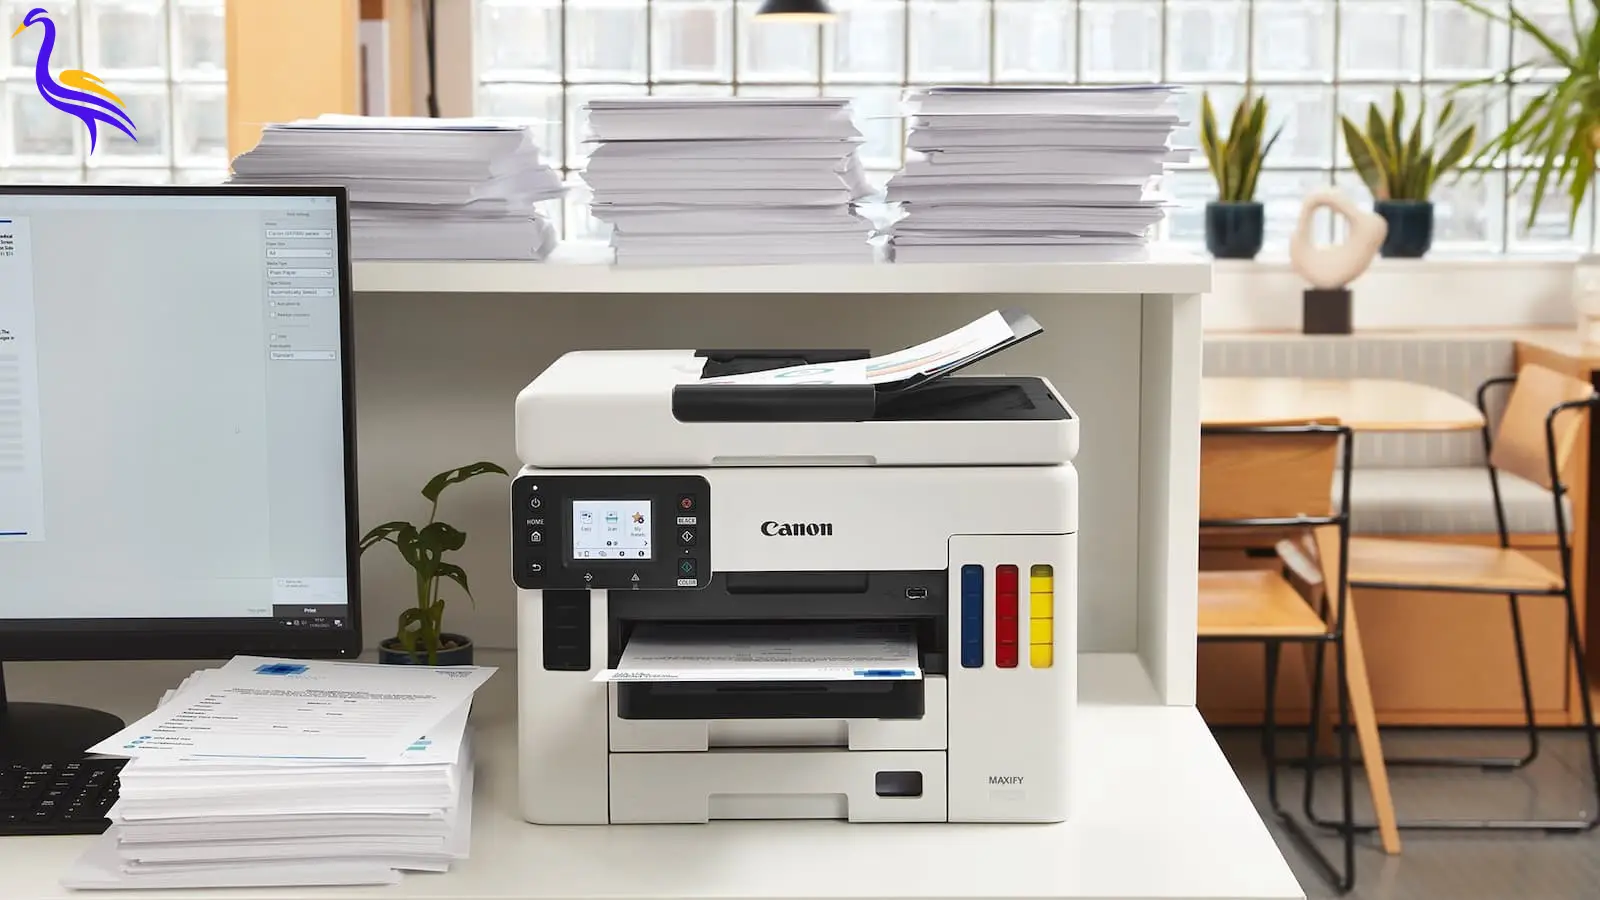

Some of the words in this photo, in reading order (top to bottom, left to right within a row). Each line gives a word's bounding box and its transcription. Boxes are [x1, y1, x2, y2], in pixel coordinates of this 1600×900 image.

[526, 518, 545, 526] HOME
[677, 516, 697, 525] BLACK
[760, 520, 833, 537] Canon
[677, 578, 698, 587] COLOR
[303, 607, 318, 615] Print
[988, 775, 1025, 785] MAXIFY
